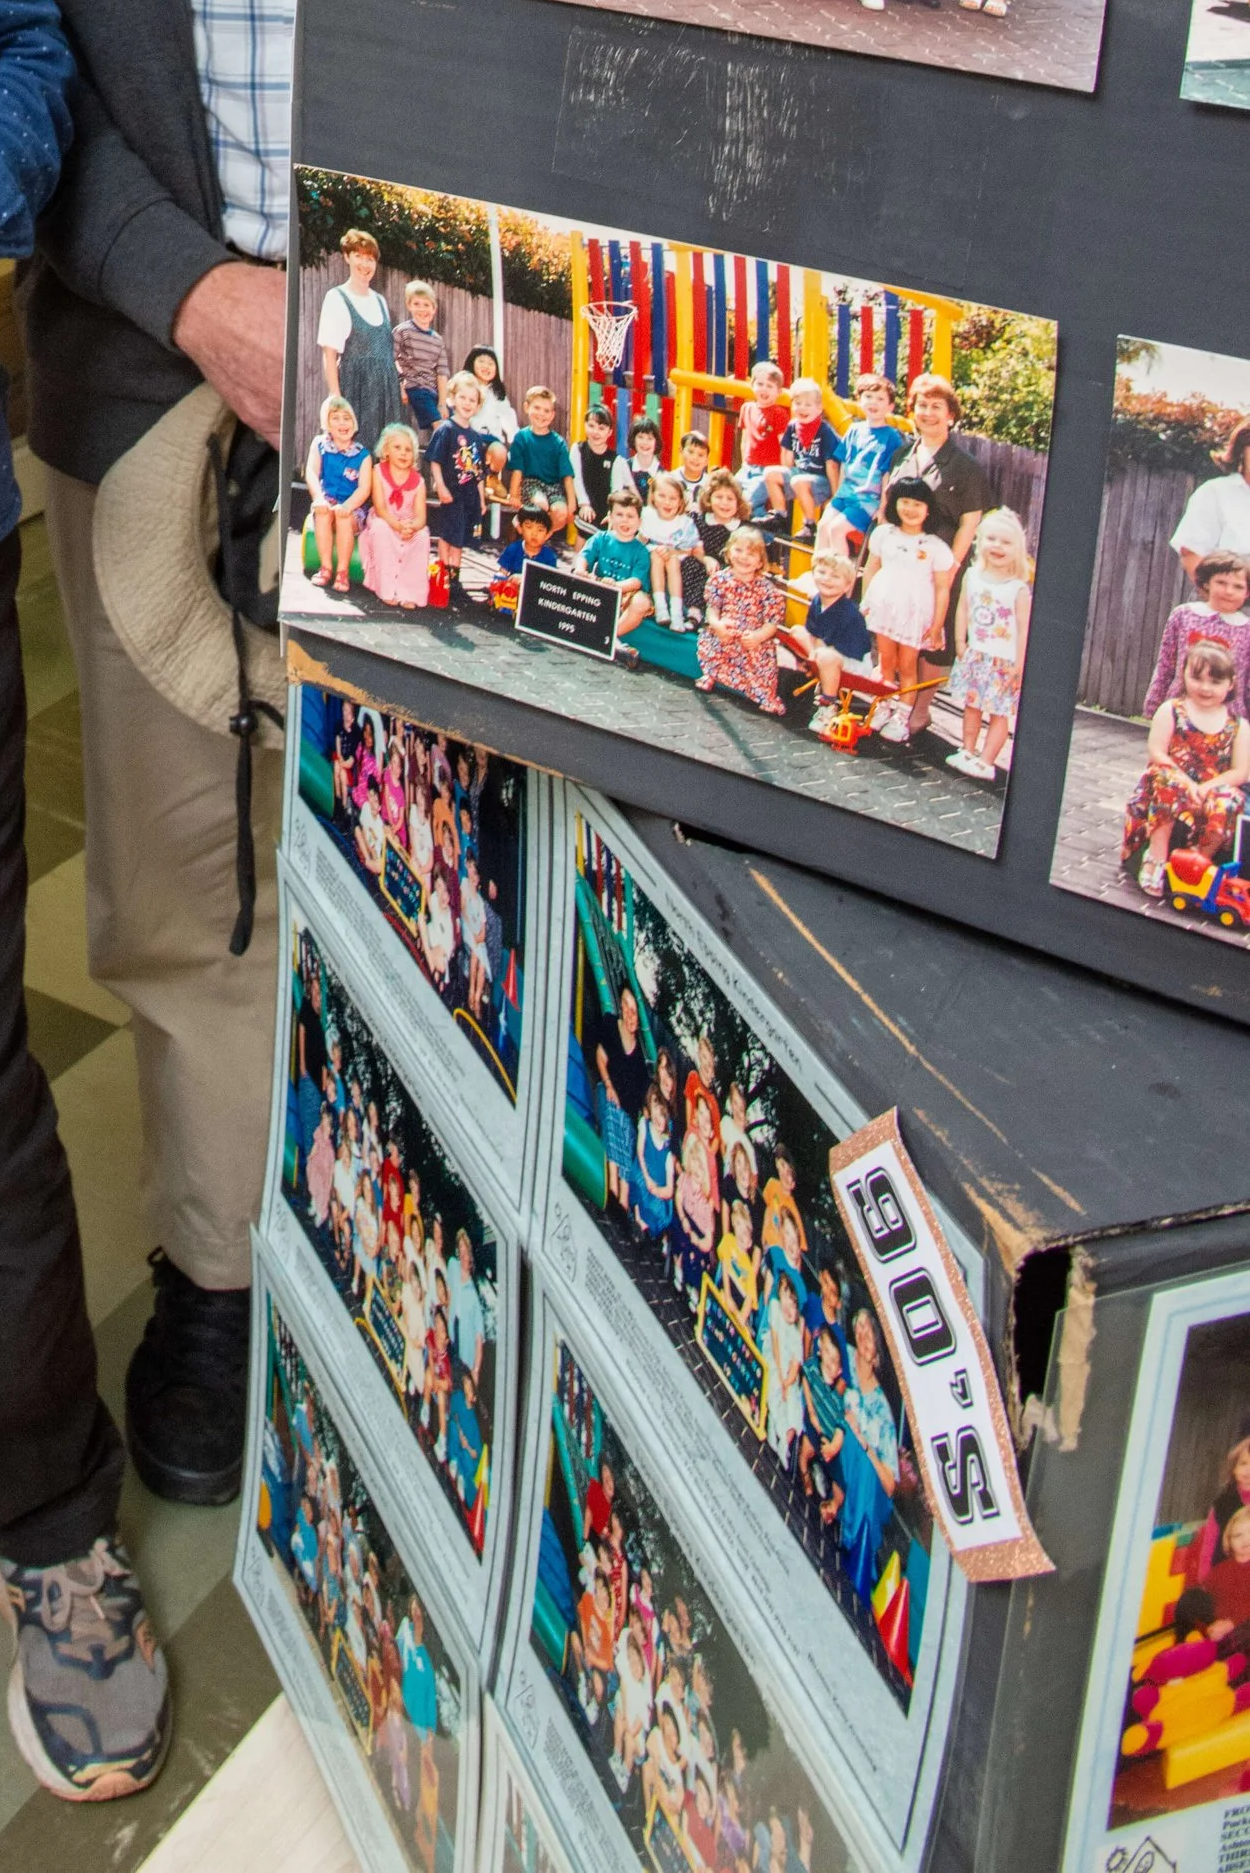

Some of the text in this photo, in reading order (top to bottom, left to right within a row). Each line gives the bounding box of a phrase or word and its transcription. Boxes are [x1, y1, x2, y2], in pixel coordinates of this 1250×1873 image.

[539, 580, 601, 607] NORTH EPPING
[538, 597, 597, 623] KINDERGARTEN
